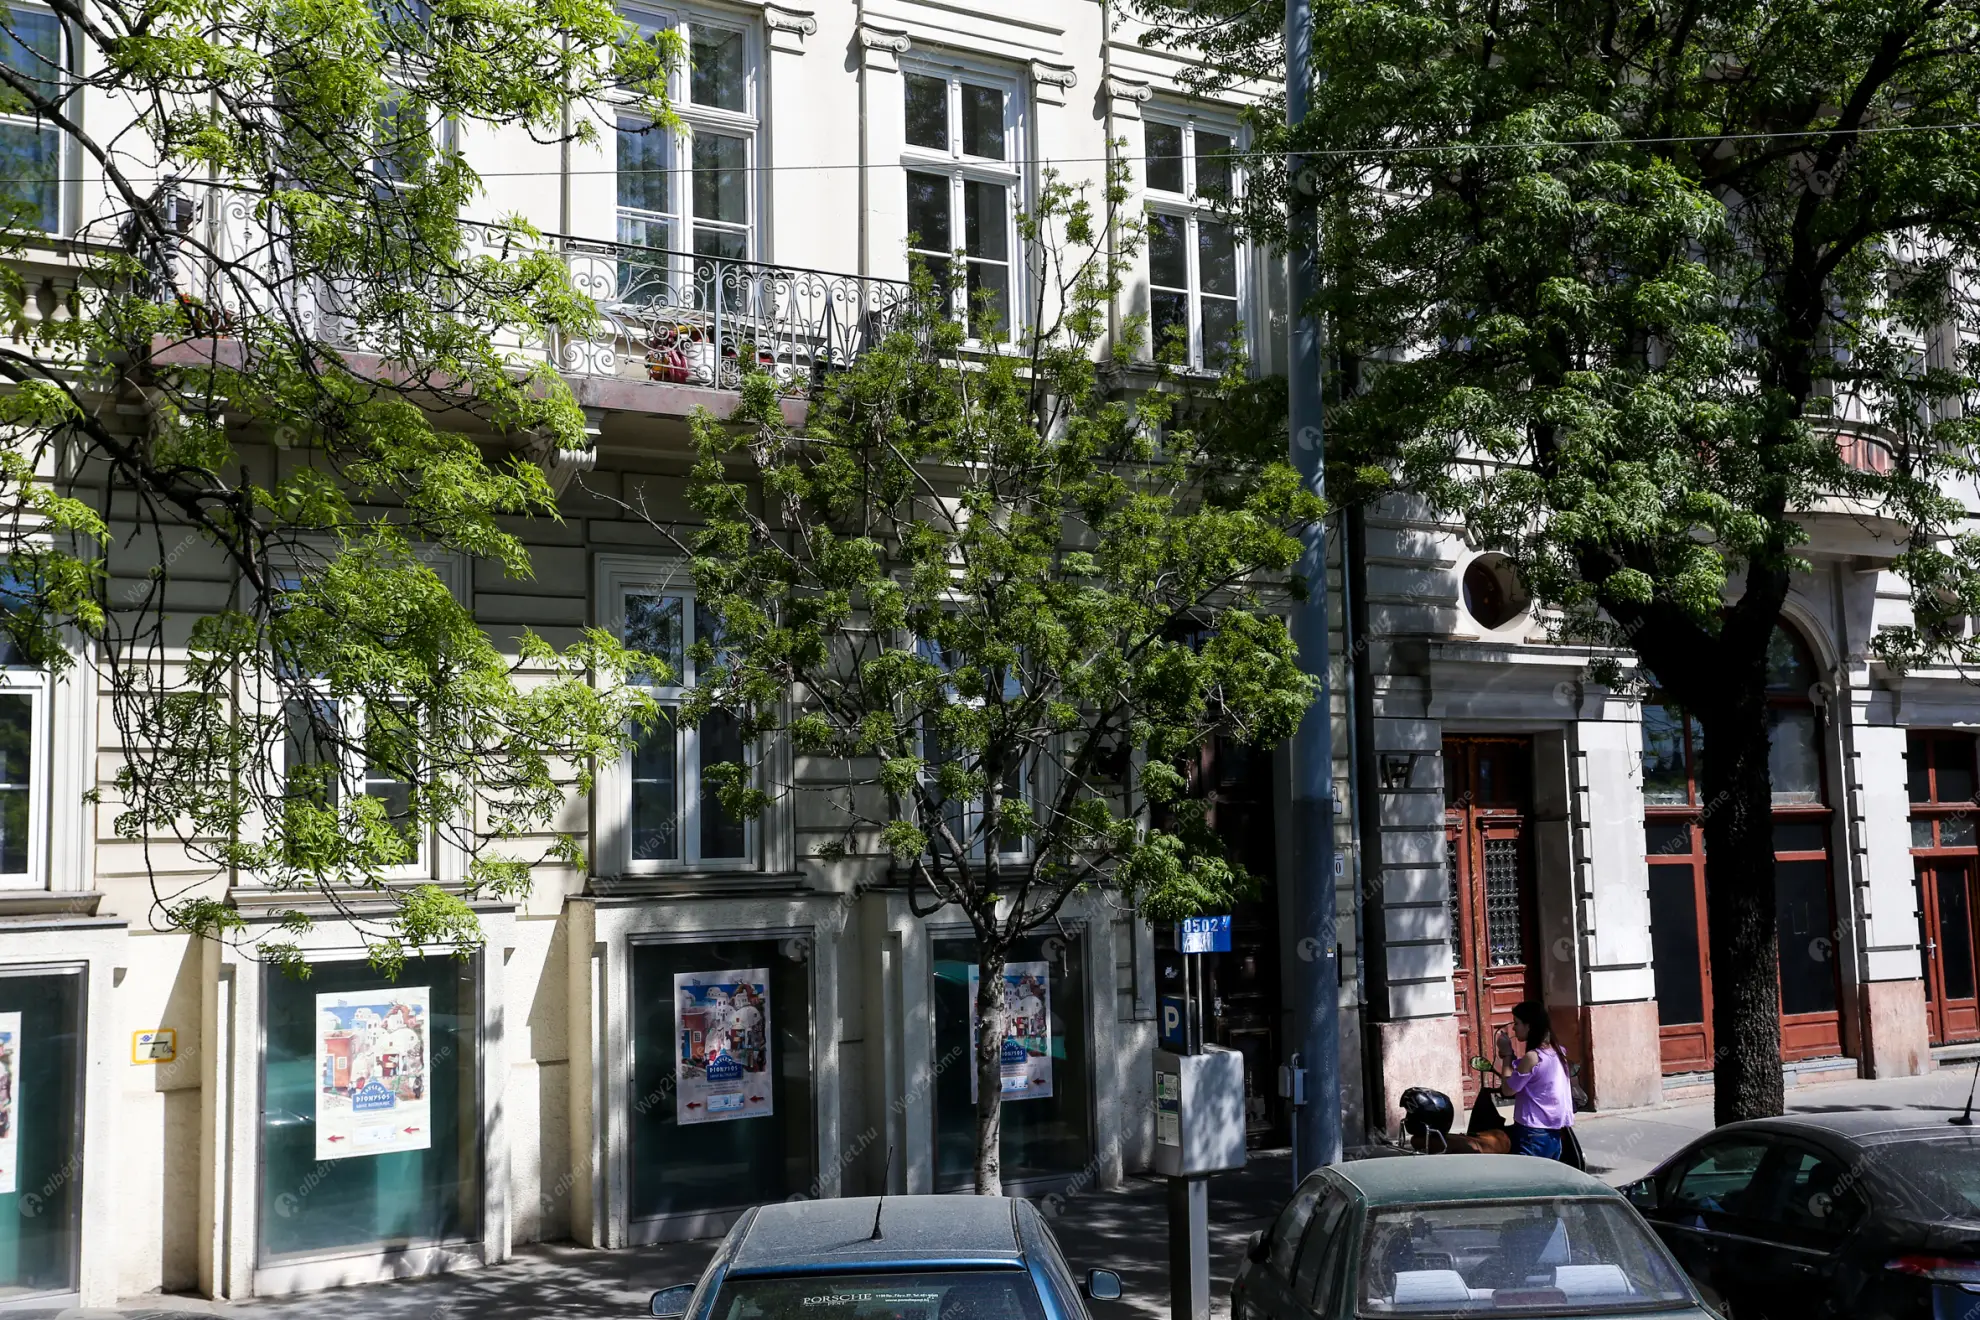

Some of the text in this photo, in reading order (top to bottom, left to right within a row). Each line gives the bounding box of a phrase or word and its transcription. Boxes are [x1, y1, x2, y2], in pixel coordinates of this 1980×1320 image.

[1184, 918, 1218, 932] 0502
[1164, 1006, 1180, 1037] P
[356, 1094, 390, 1103] DIONYSOS
[803, 1294, 872, 1304] PORSCHE
